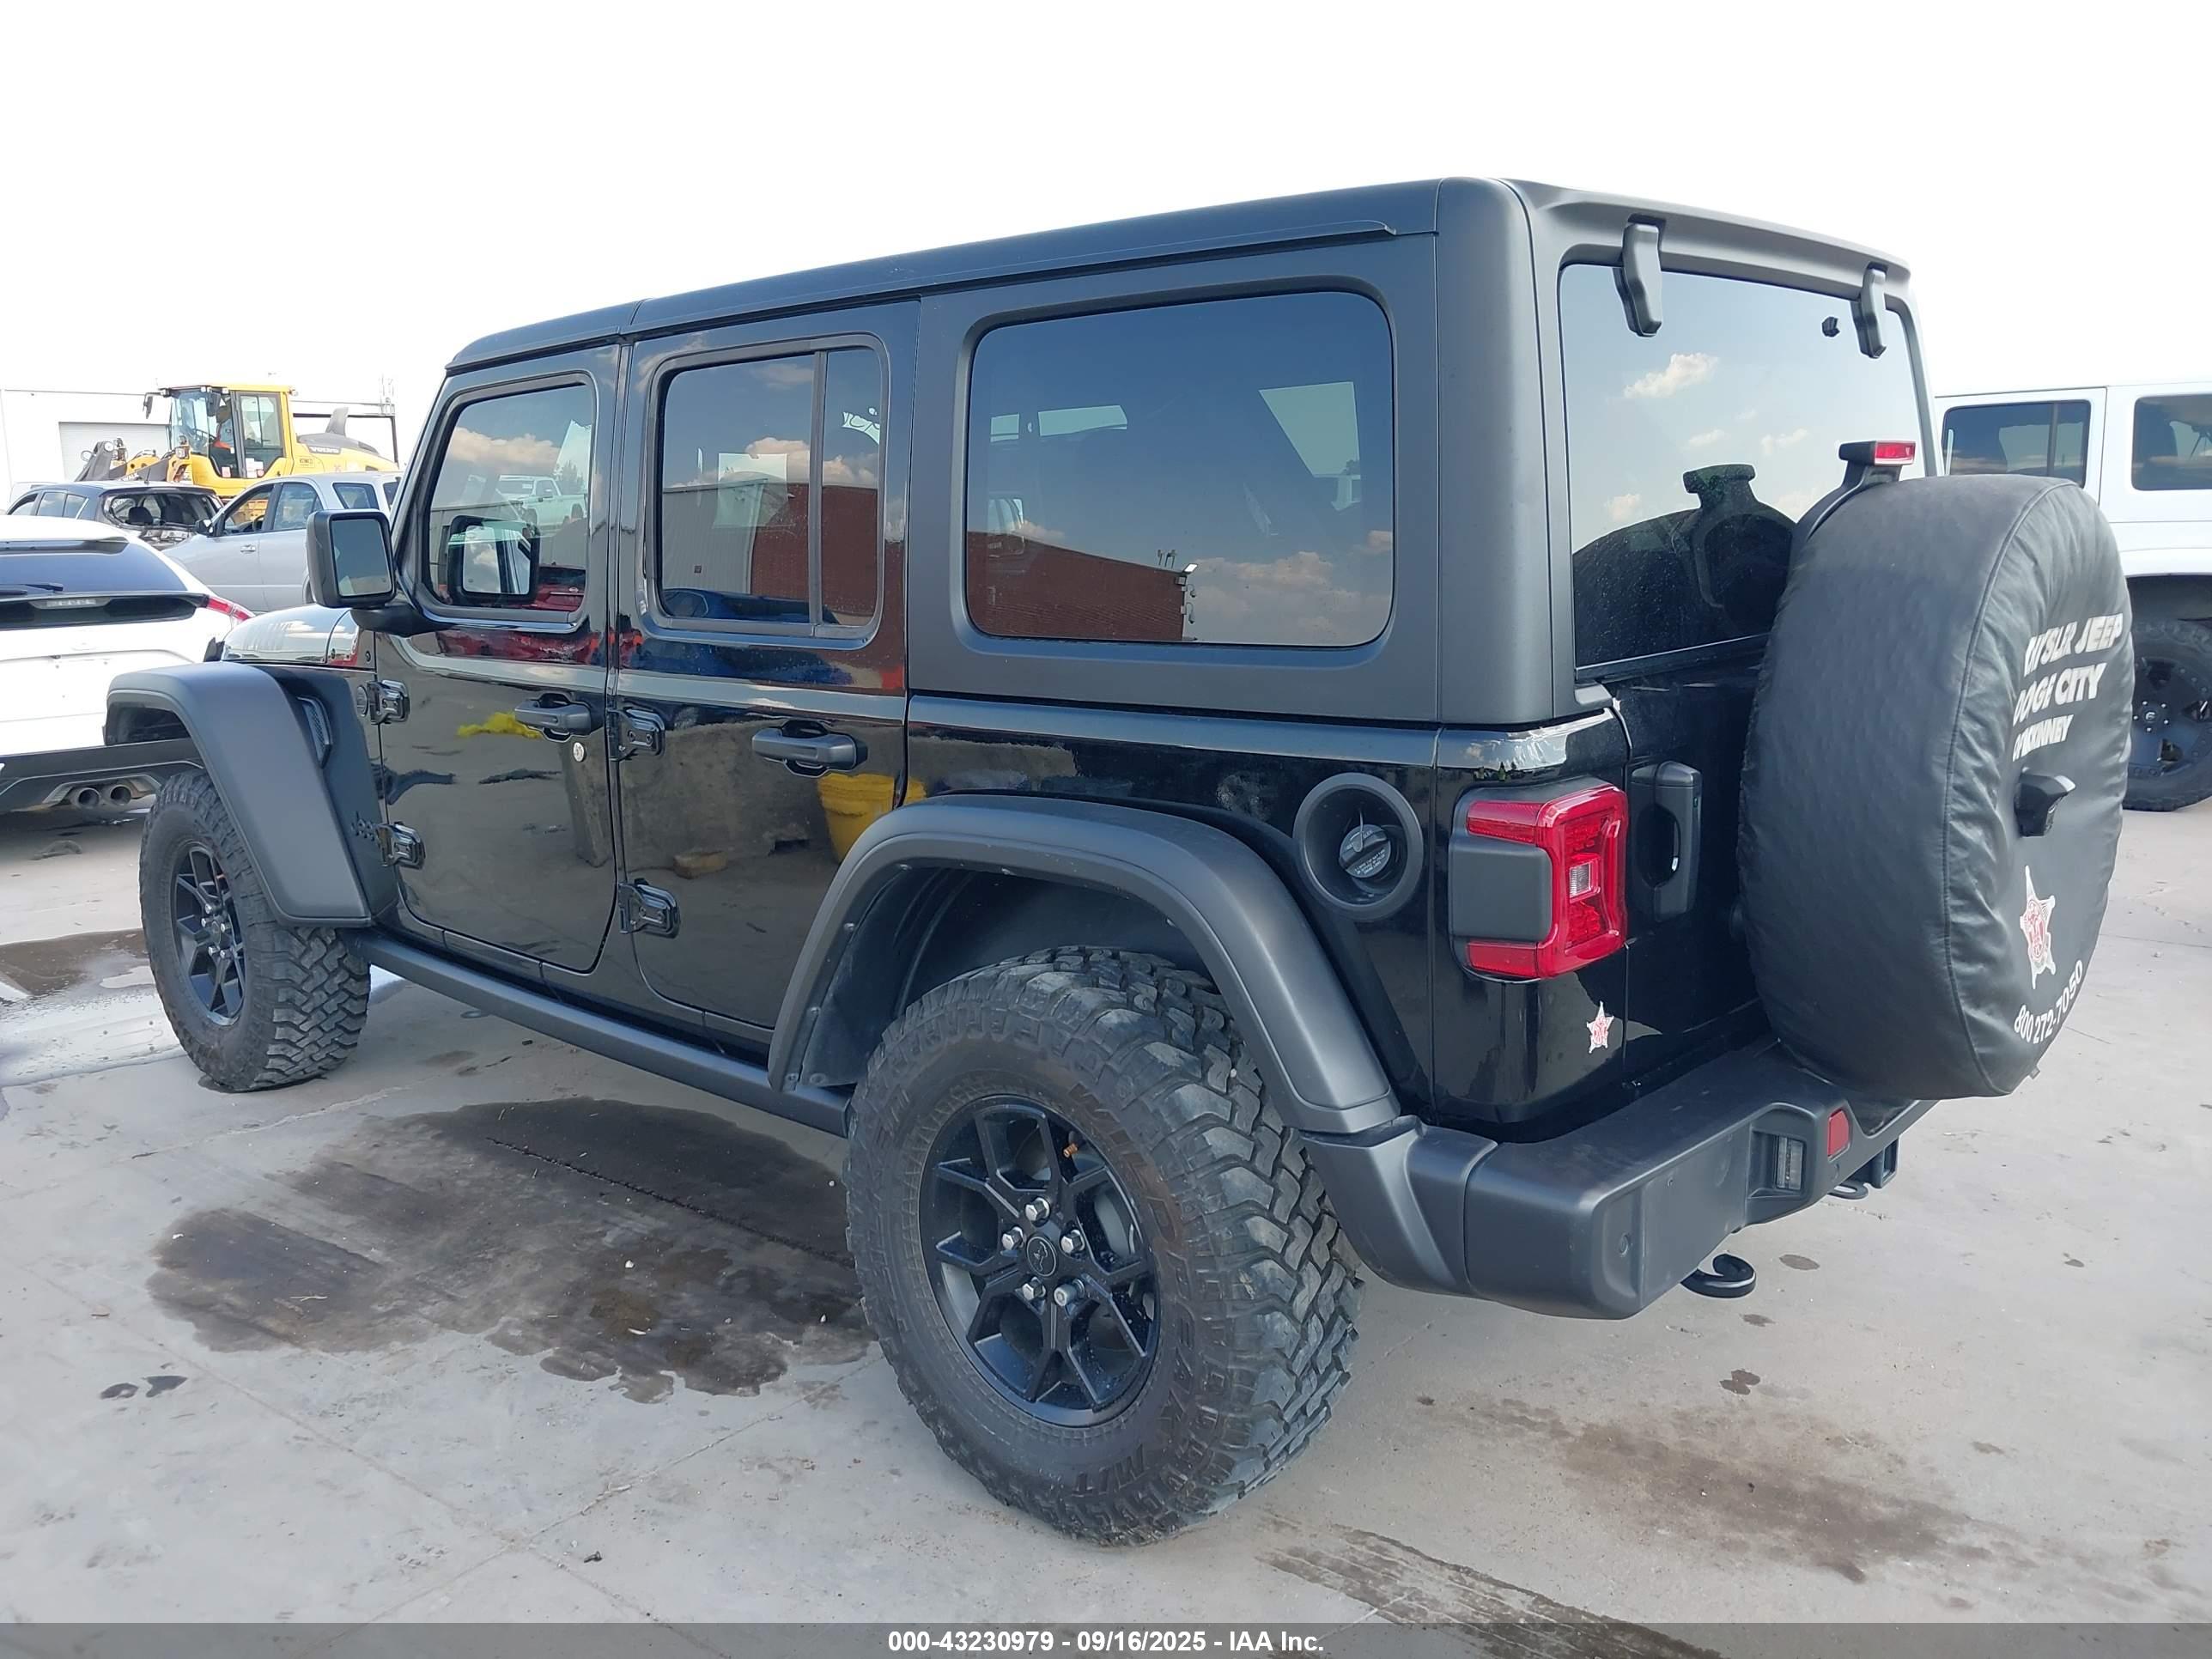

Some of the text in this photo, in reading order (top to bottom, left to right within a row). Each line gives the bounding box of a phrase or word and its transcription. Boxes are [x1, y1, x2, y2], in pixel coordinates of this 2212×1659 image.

[2075, 613, 2124, 653] JEEP
[2055, 662, 2107, 705] CITY
[2014, 960, 2083, 1043] 800 272-7050
